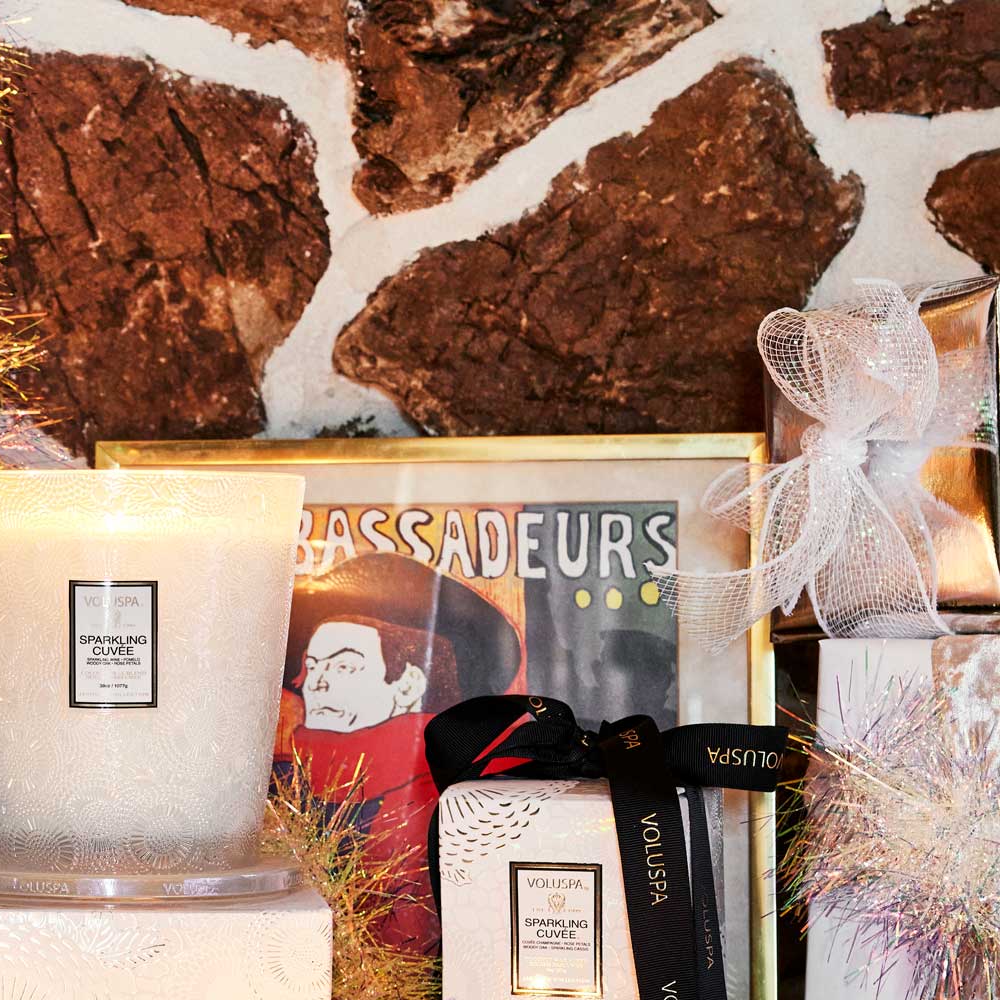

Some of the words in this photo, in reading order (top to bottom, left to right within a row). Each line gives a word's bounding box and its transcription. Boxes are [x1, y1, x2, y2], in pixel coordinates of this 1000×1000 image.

[84, 595, 139, 608] VOSPA
[79, 635, 147, 645] SPARKLING
[92, 645, 134, 656] CUVÉE
[640, 812, 668, 906] VOLUSPA
[527, 878, 583, 890] VOLUSPA
[524, 918, 588, 929] SPARKLING
[536, 927, 576, 939] CUVÉE
